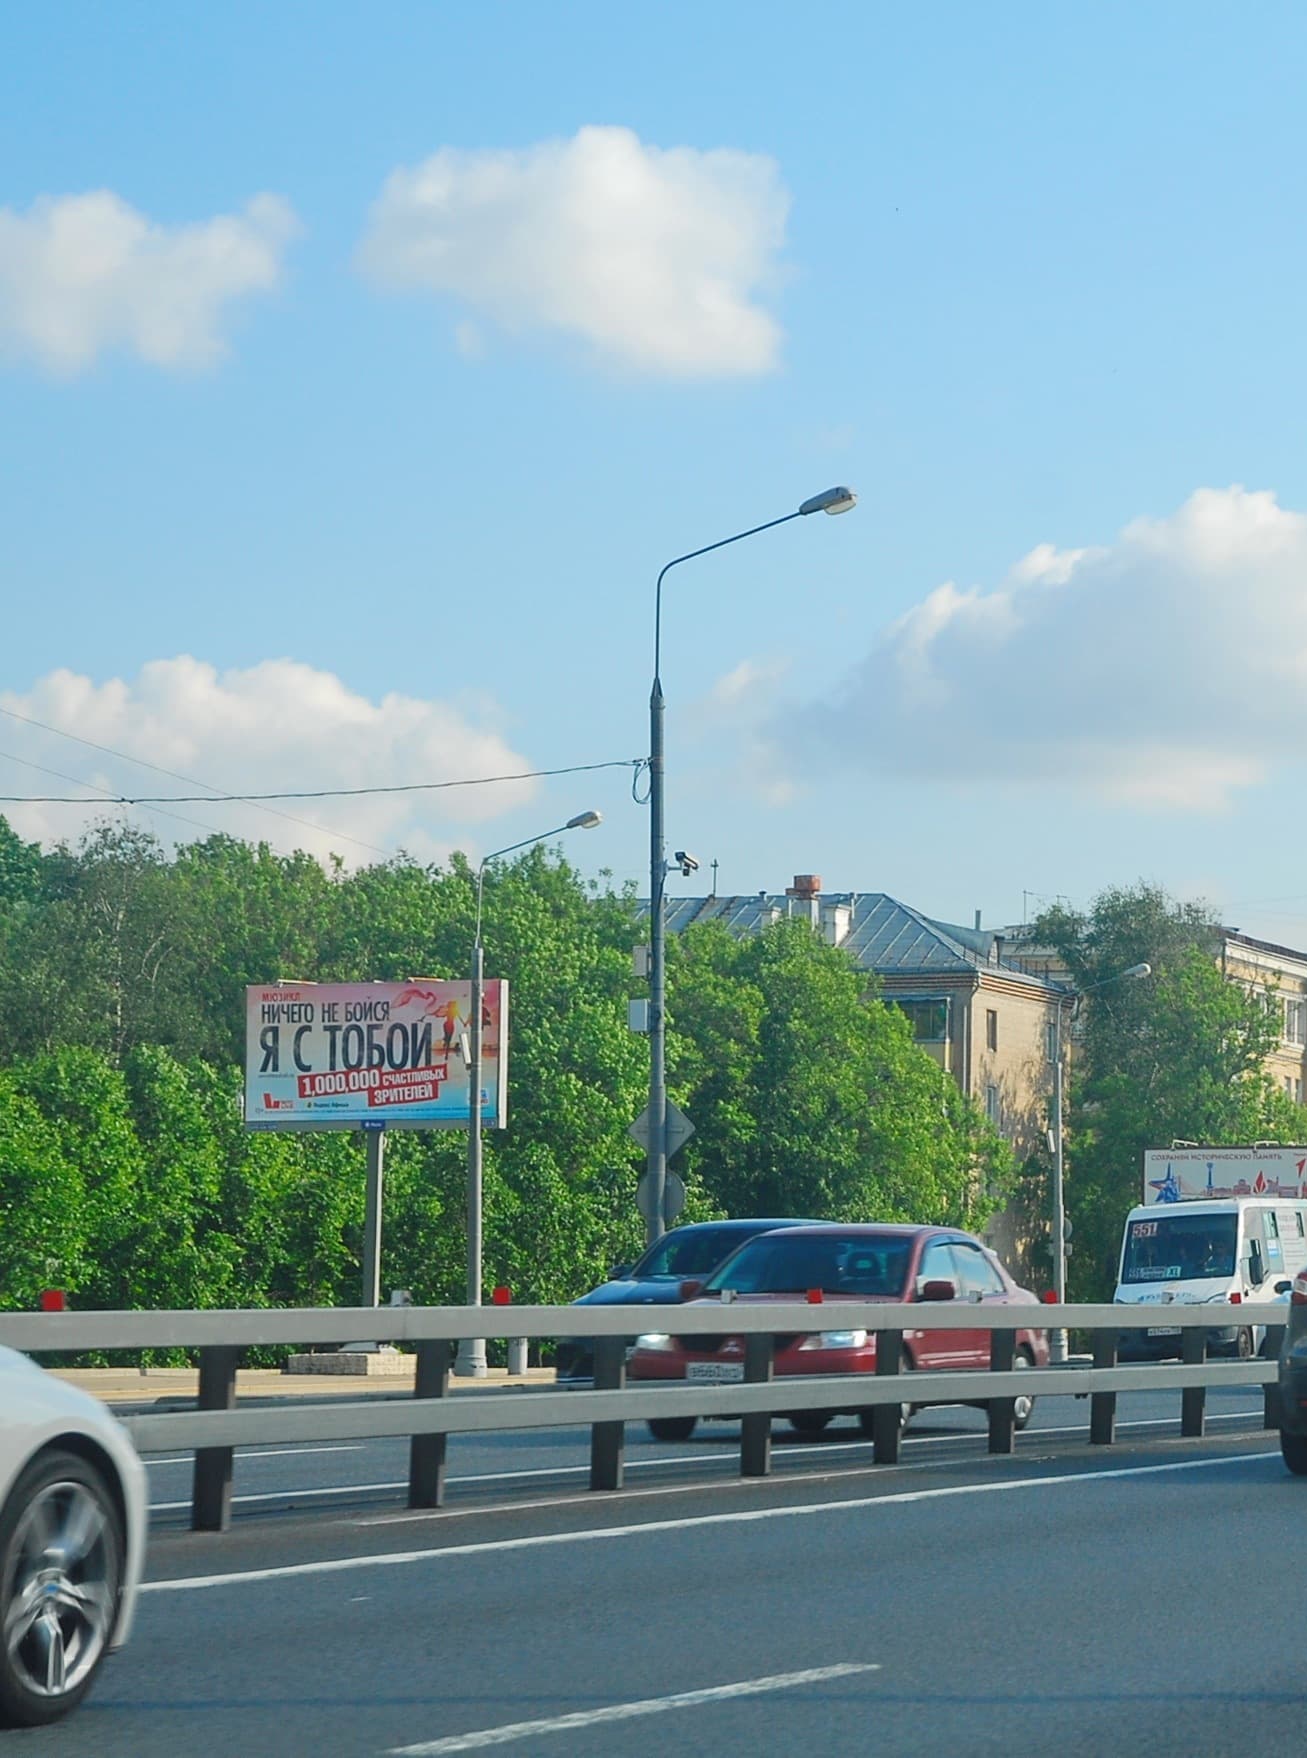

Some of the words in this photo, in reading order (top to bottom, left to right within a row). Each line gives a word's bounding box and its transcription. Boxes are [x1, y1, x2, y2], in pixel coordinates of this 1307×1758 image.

[262, 1003, 315, 1024] НИЧЕГО
[321, 1002, 339, 1023] НЕ
[344, 997, 390, 1022] БОЙСЯ
[259, 1026, 280, 1072] Я
[293, 1025, 313, 1072] С
[303, 1069, 380, 1096] 1,000,000
[382, 1068, 445, 1086] СЧАСТЛИВЫХ
[374, 1082, 433, 1104] ЗРИТЕЛЕЙ
